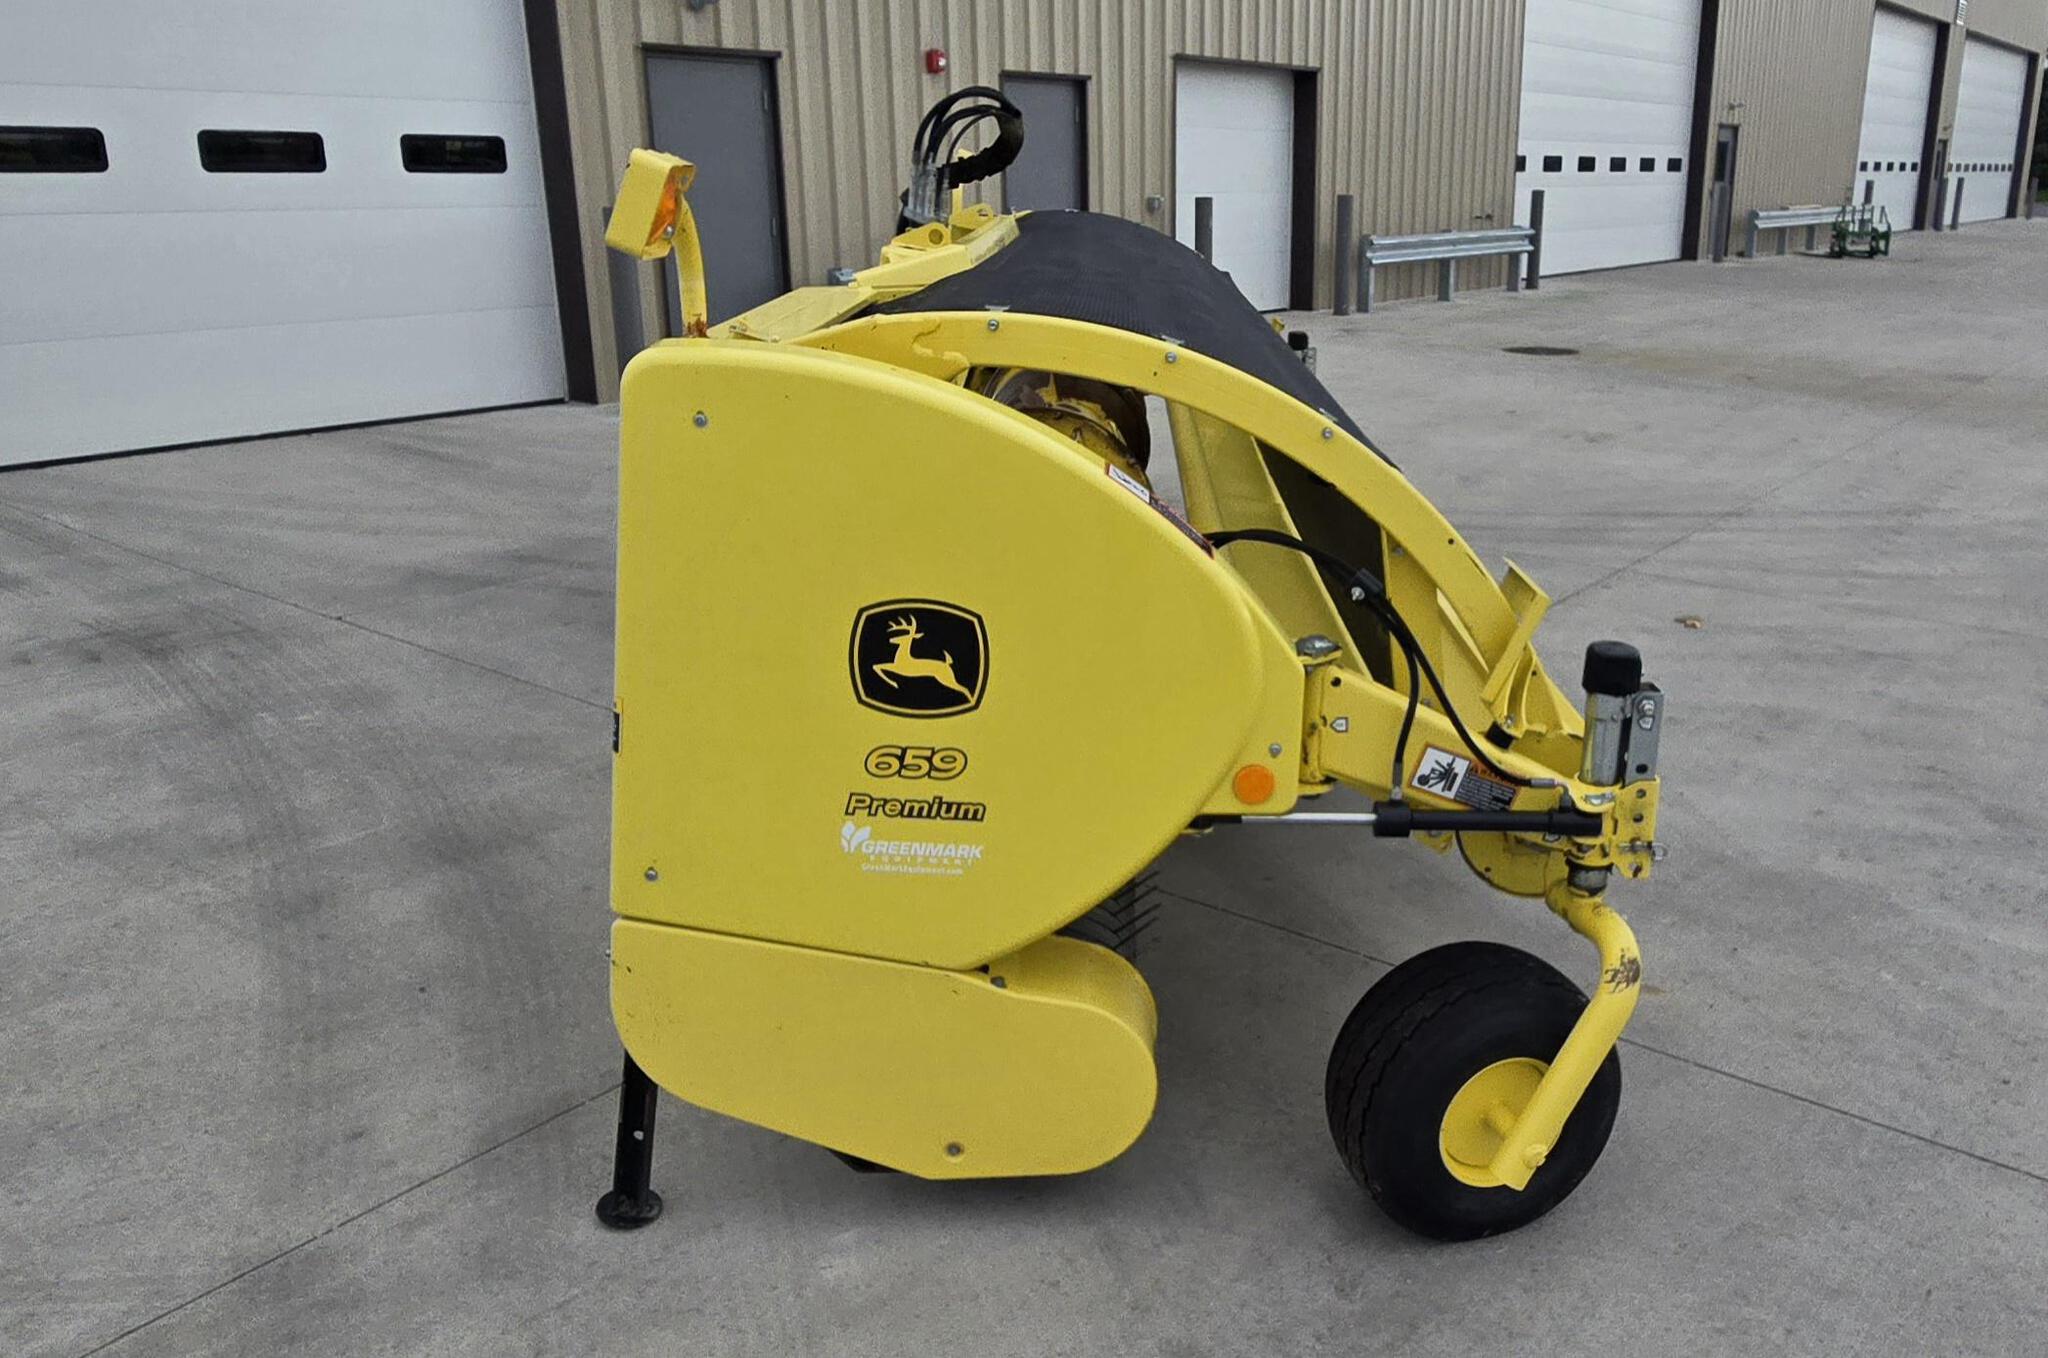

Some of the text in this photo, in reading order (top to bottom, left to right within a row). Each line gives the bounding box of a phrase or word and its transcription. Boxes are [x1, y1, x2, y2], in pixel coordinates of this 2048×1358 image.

[864, 745, 968, 781] 659
[845, 792, 986, 821] Premium
[861, 840, 983, 859] GREENMARK
